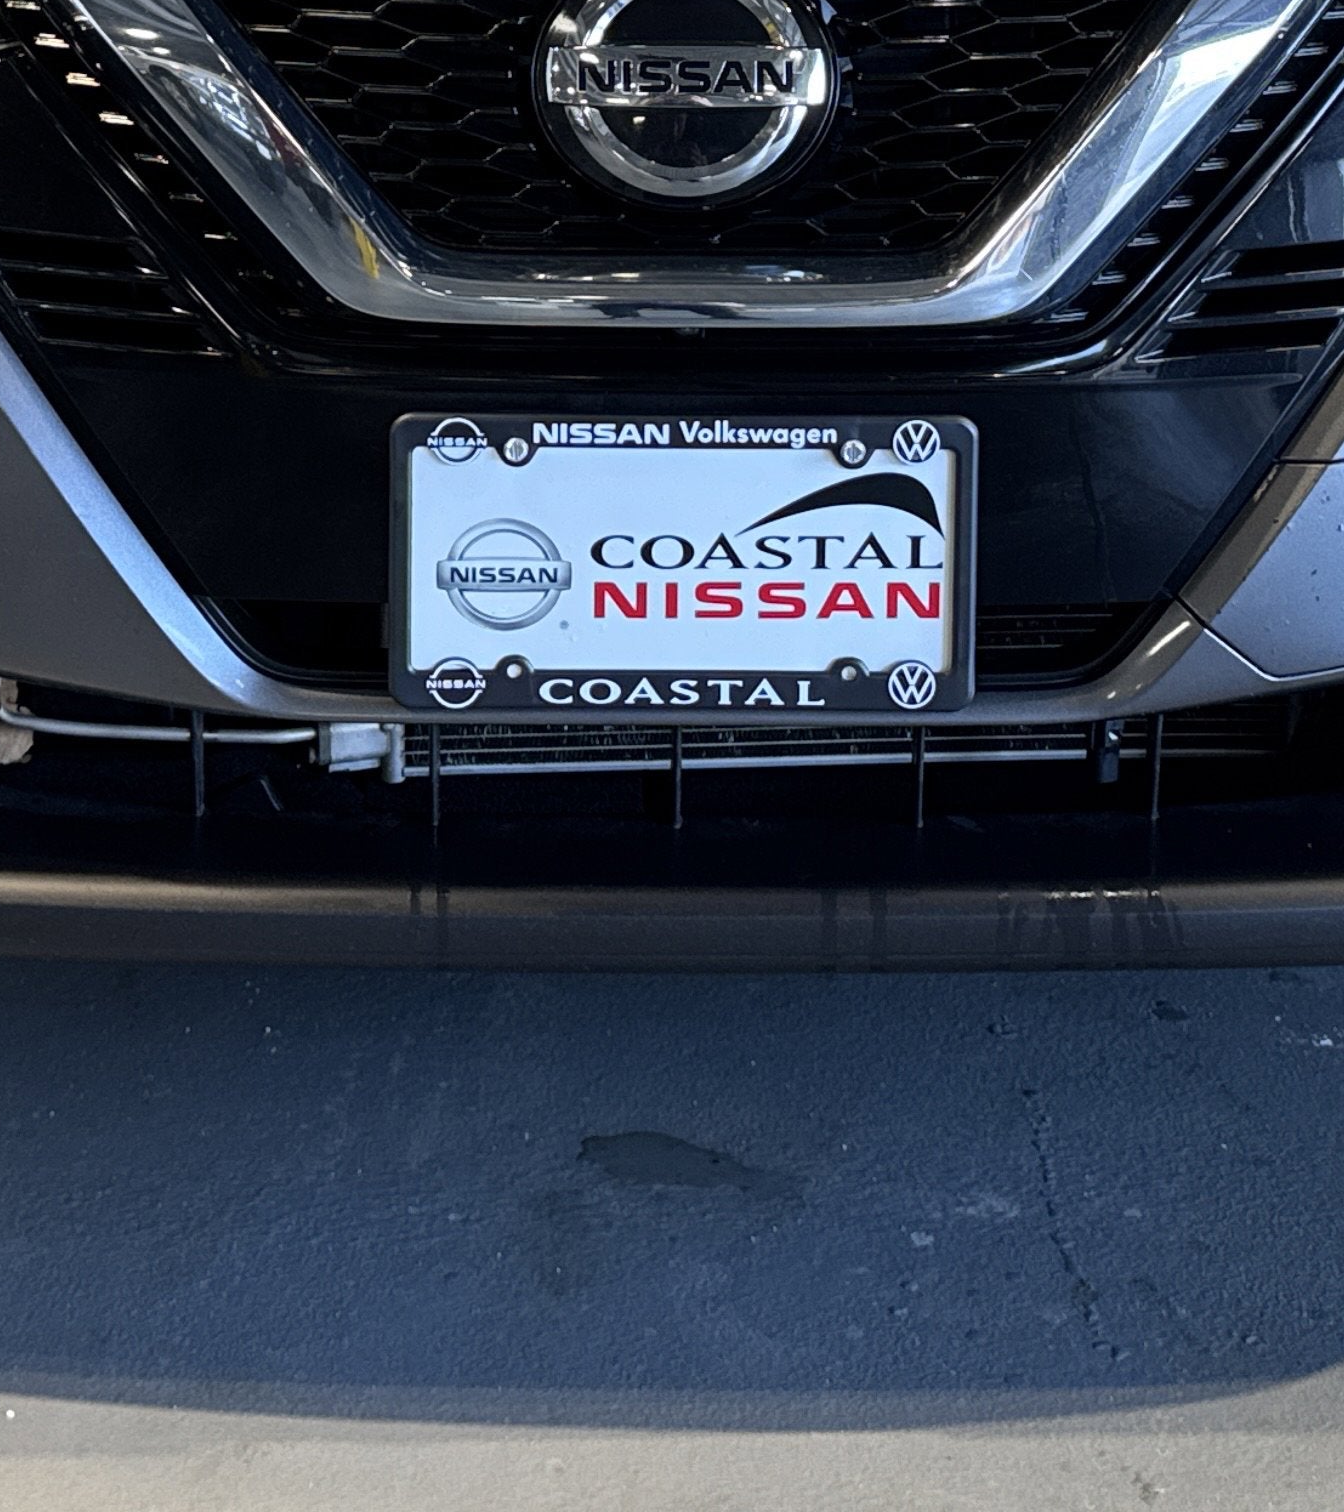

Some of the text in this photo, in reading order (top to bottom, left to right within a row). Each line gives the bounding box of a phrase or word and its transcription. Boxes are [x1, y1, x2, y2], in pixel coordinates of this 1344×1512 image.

[578, 60, 794, 94] NISSAN
[427, 434, 488, 448] NISSAN
[533, 420, 838, 446] NISSAN Volkswagen
[590, 532, 944, 570] COASTAL
[450, 567, 559, 584] NISSAN
[593, 582, 942, 619] NISSAN
[426, 677, 486, 690] NISSAN
[539, 678, 826, 707] COASTAL
